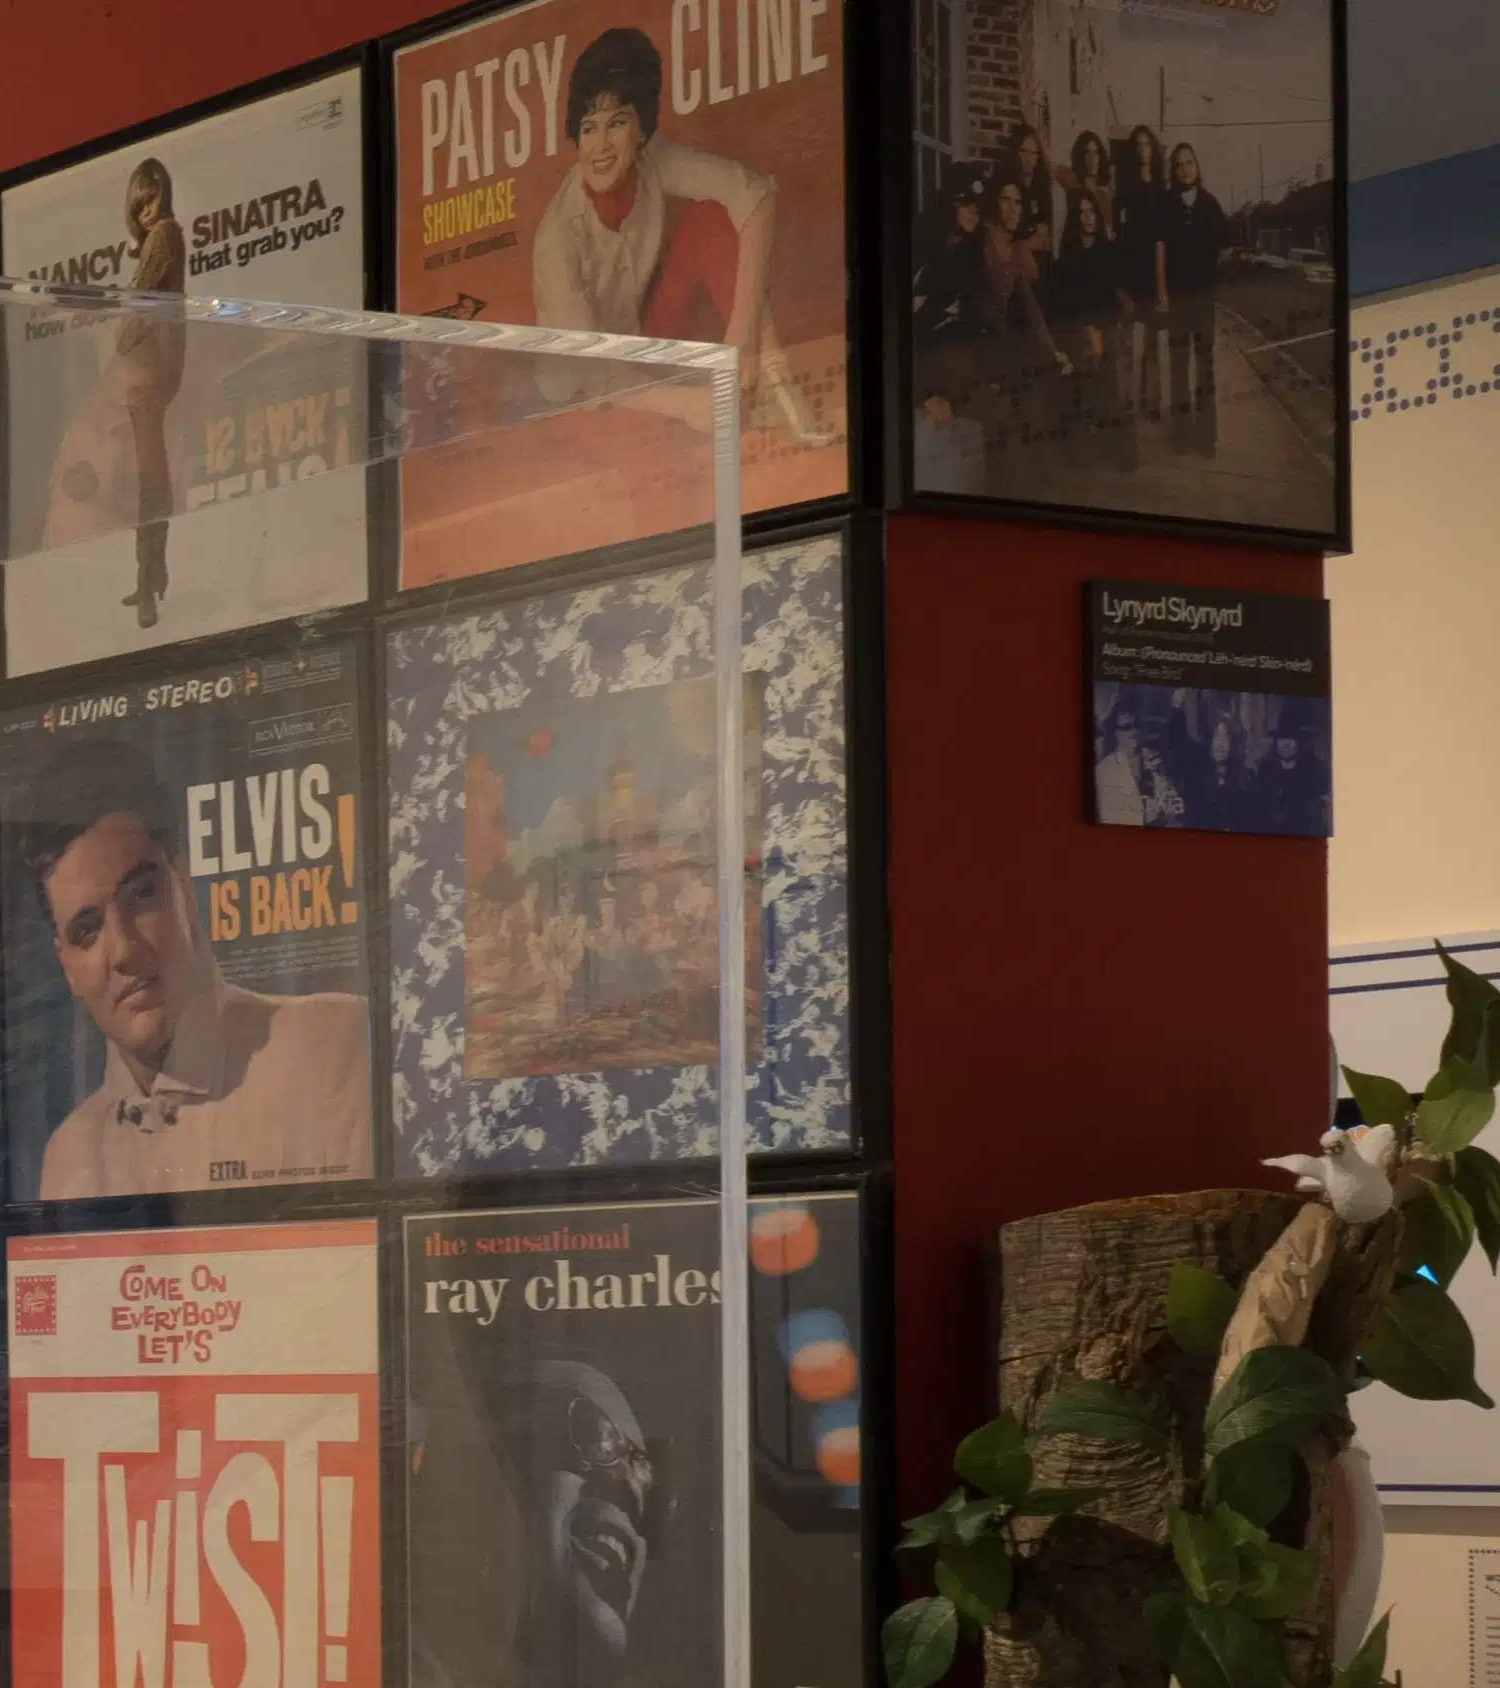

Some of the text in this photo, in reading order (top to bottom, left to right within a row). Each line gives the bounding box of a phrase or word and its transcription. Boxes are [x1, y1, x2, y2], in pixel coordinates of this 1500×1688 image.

[420, 0, 828, 196] PATSY CLINE
[191, 179, 327, 249] SINATRA
[423, 180, 517, 245] SHOWCASE
[189, 206, 345, 277] that grab you?
[1103, 592, 1243, 631] Lynyrd Skynyrd
[59, 676, 233, 727] LIVING STEREO
[186, 763, 332, 877] ELVIS
[210, 880, 240, 942] IS
[424, 1223, 631, 1258] the sensational
[119, 1264, 227, 1303] COME ON
[423, 1276, 509, 1325] ray
[111, 1299, 243, 1332] EVERYBODY
[137, 1329, 213, 1364] LET'S
